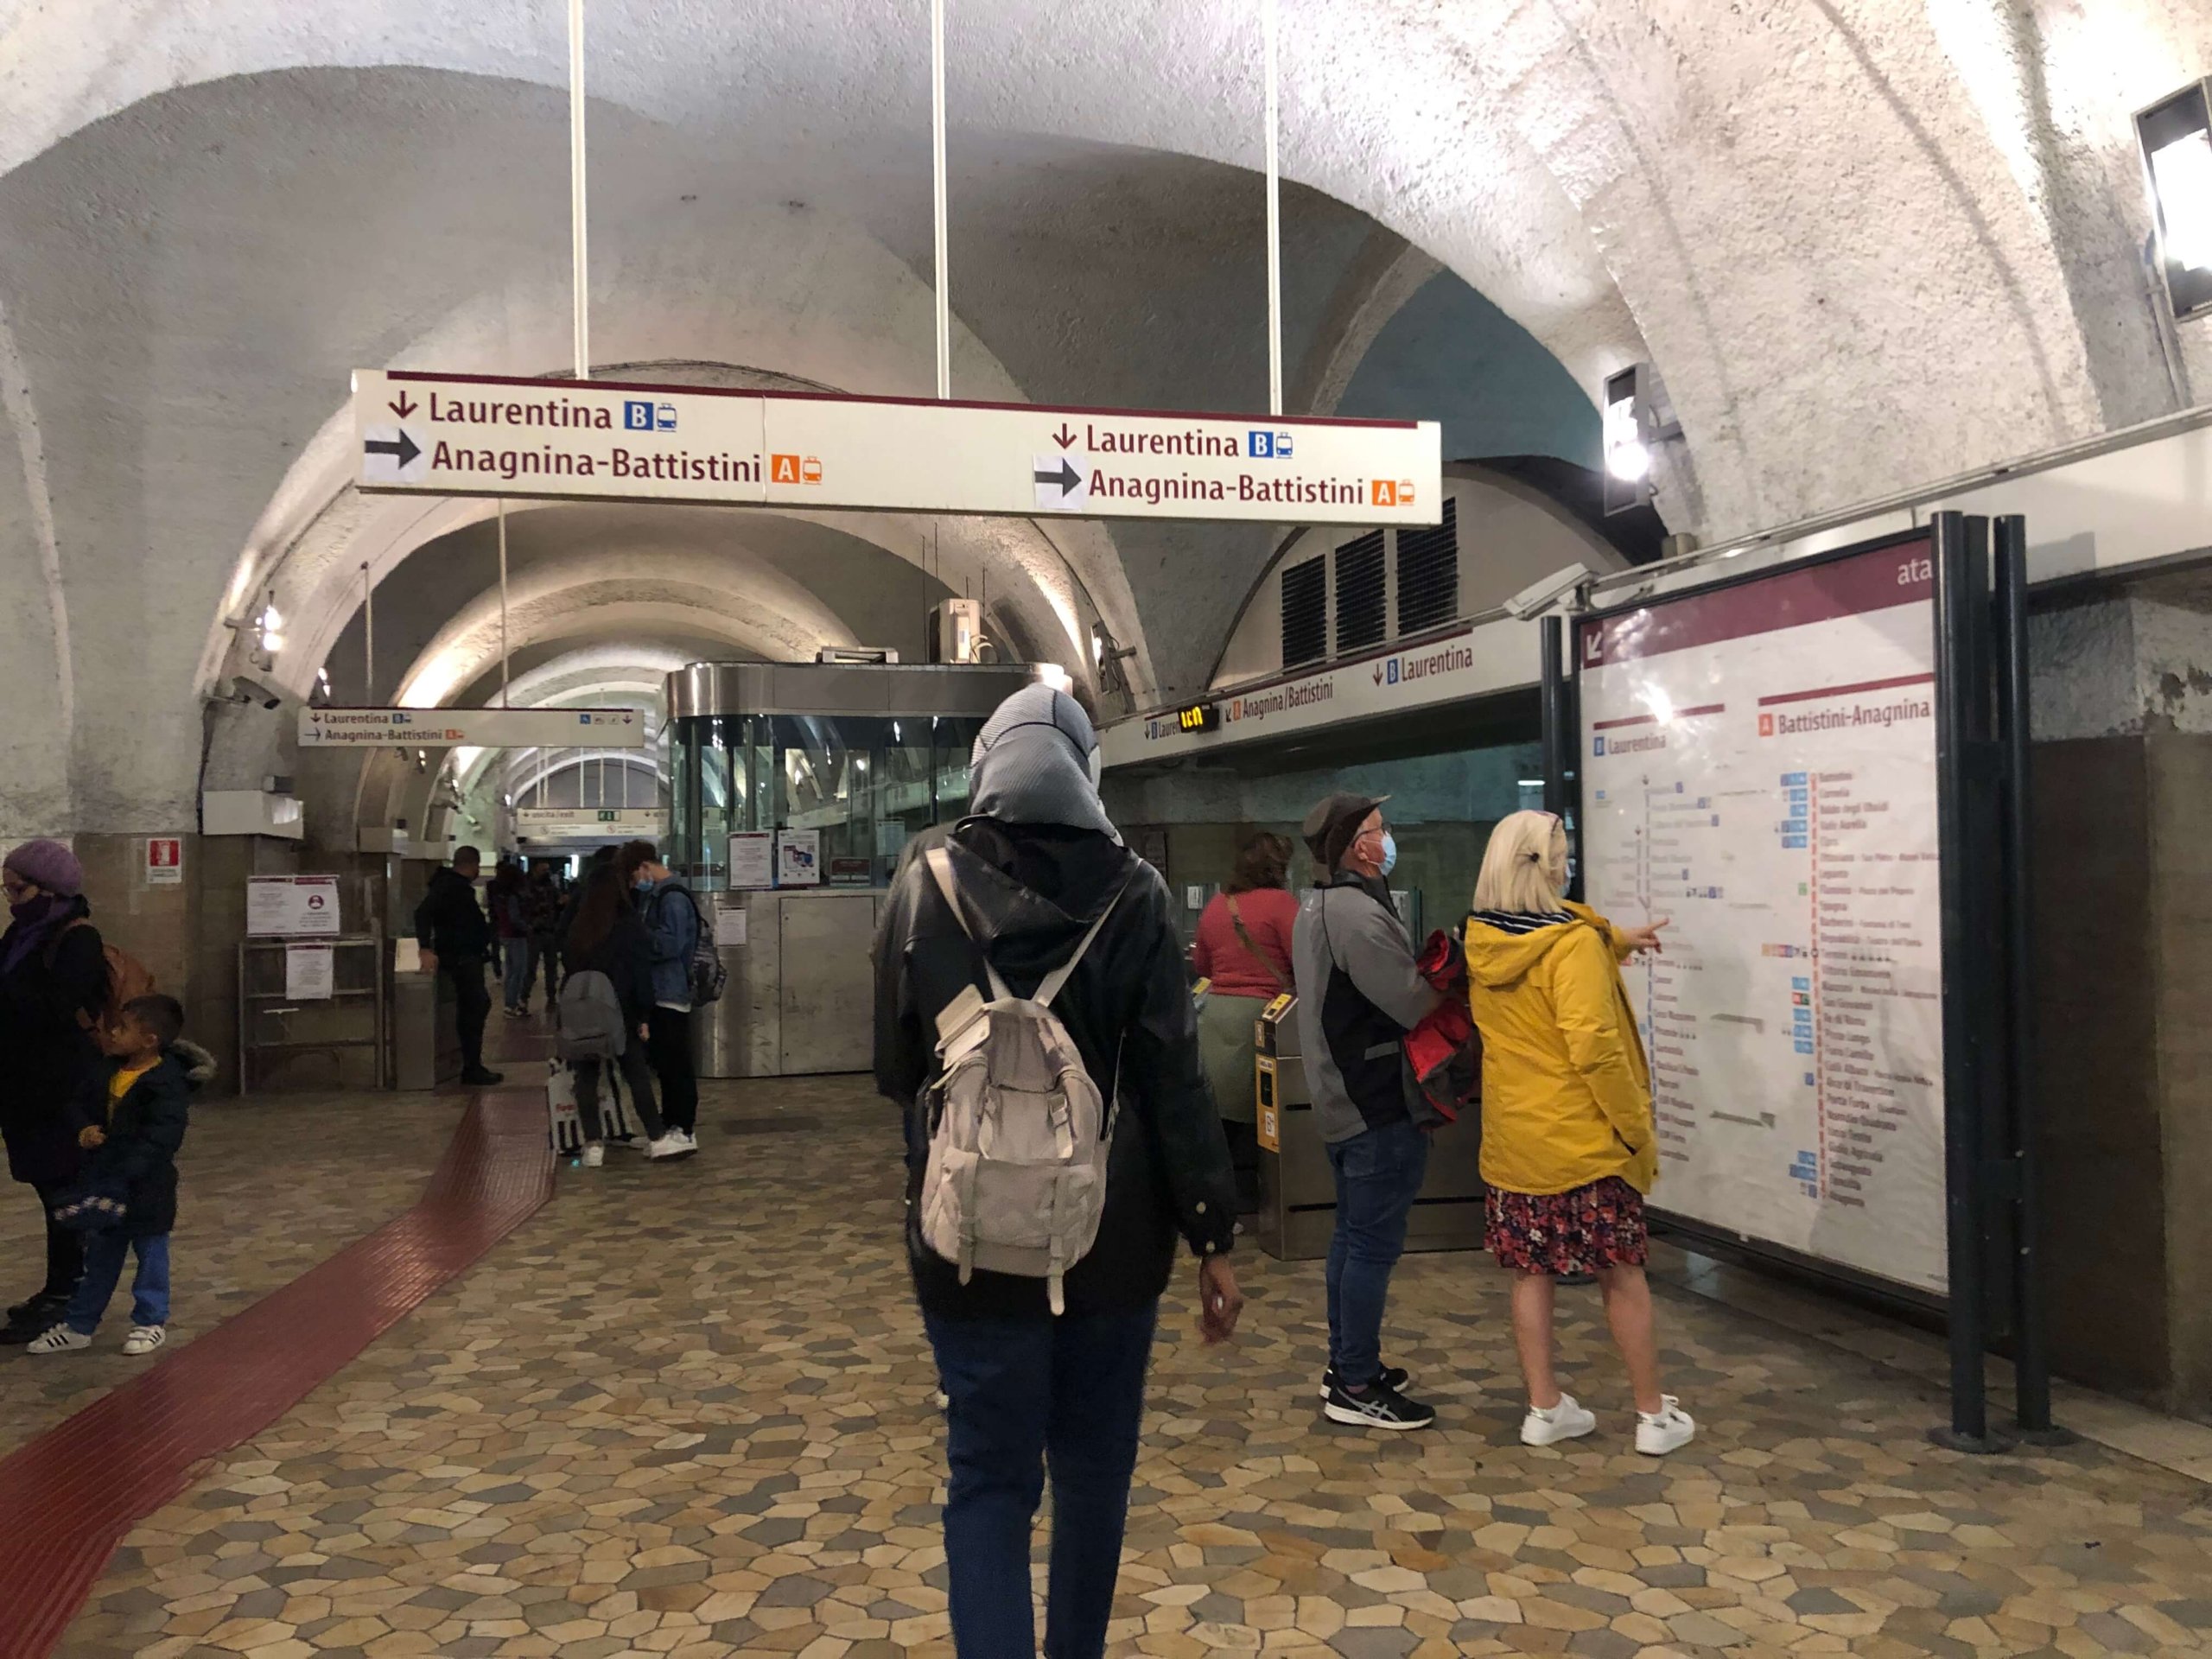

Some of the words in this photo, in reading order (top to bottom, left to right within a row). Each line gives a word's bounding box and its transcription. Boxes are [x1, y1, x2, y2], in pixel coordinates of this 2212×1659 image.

[429, 391, 613, 429] Laurentina
[1087, 423, 1239, 457] Laurentina
[432, 441, 762, 483] Anagnina-Battistini
[1089, 469, 1363, 505] Anagnina-Battistini
[1401, 645, 1472, 683] Laurentina
[324, 714, 389, 724] Laurentina
[1778, 698, 1930, 734] Battistini-Anagnina
[325, 729, 442, 741] Anagnina-Battistini
[1608, 733, 1666, 755] Laurentina
